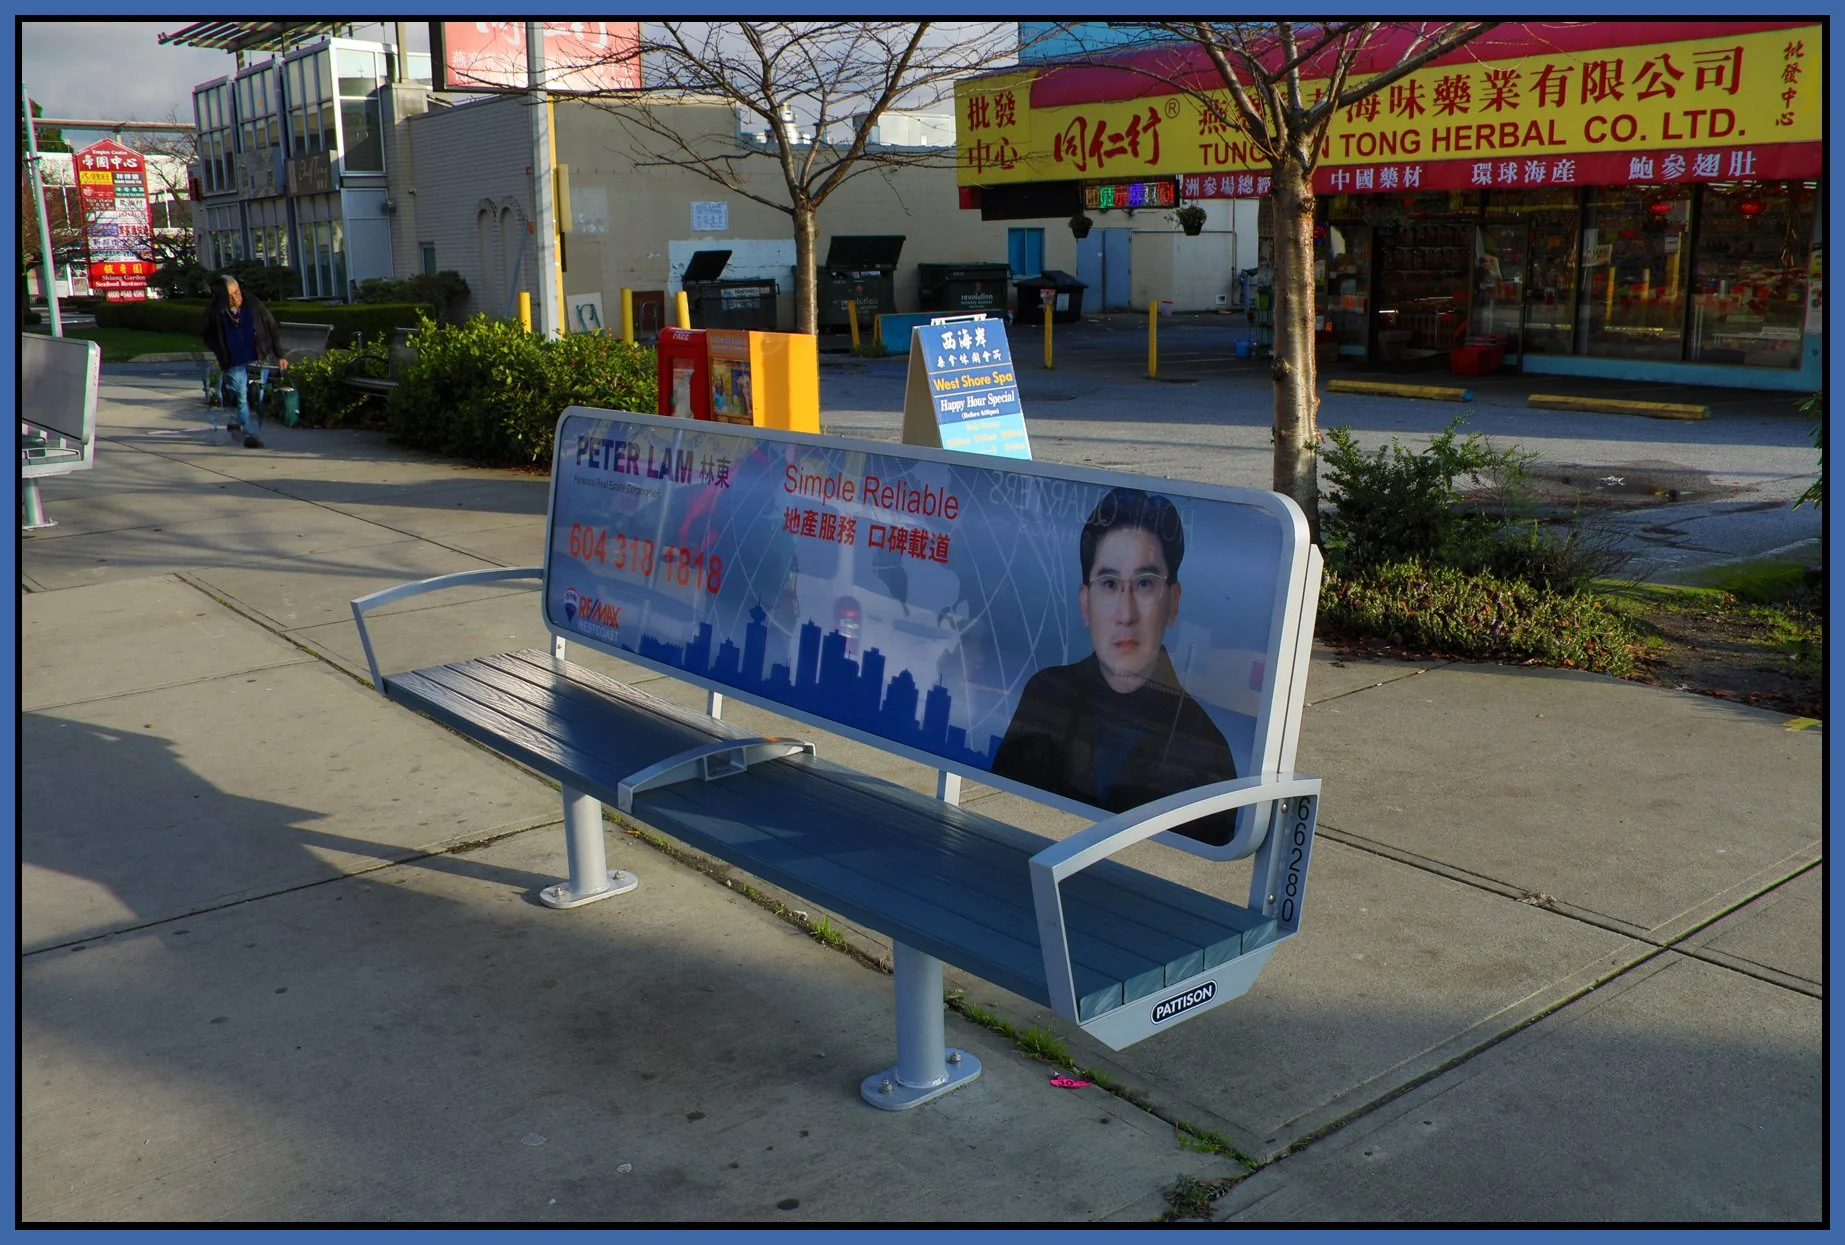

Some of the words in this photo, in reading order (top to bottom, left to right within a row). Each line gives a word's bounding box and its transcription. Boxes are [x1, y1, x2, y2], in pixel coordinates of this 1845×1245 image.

[968, 90, 1016, 131] 批發
[1054, 106, 1162, 172] 同仁行
[1342, 128, 1421, 158] TONG
[1432, 119, 1567, 153] HERBAL
[1584, 113, 1647, 144] CO.
[1662, 107, 1746, 141] LTD.
[968, 136, 1018, 174] 中心
[1330, 165, 1422, 191] 中國藥材
[941, 327, 987, 350] 西海岸
[933, 377, 960, 391] West
[961, 374, 991, 388] Shore
[992, 370, 1013, 386] Spa
[940, 399, 965, 413] Happy
[966, 396, 987, 408] Hour
[987, 390, 1015, 407] Special
[576, 435, 640, 476] PETER
[646, 444, 694, 484] LAM
[699, 454, 731, 489] 林東
[597, 477, 609, 489] Real
[609, 480, 626, 492] Estate
[784, 464, 856, 506] Simple
[862, 475, 959, 520] Reliable
[783, 505, 857, 545] 地產服務
[867, 524, 951, 565] 口碑載道
[569, 523, 607, 564] 604
[613, 533, 655, 577] 318
[663, 544, 723, 595] 1818
[579, 596, 620, 629] RE/MAX
[1281, 796, 1310, 922] 66280
[1156, 985, 1212, 1020] PATTISON
